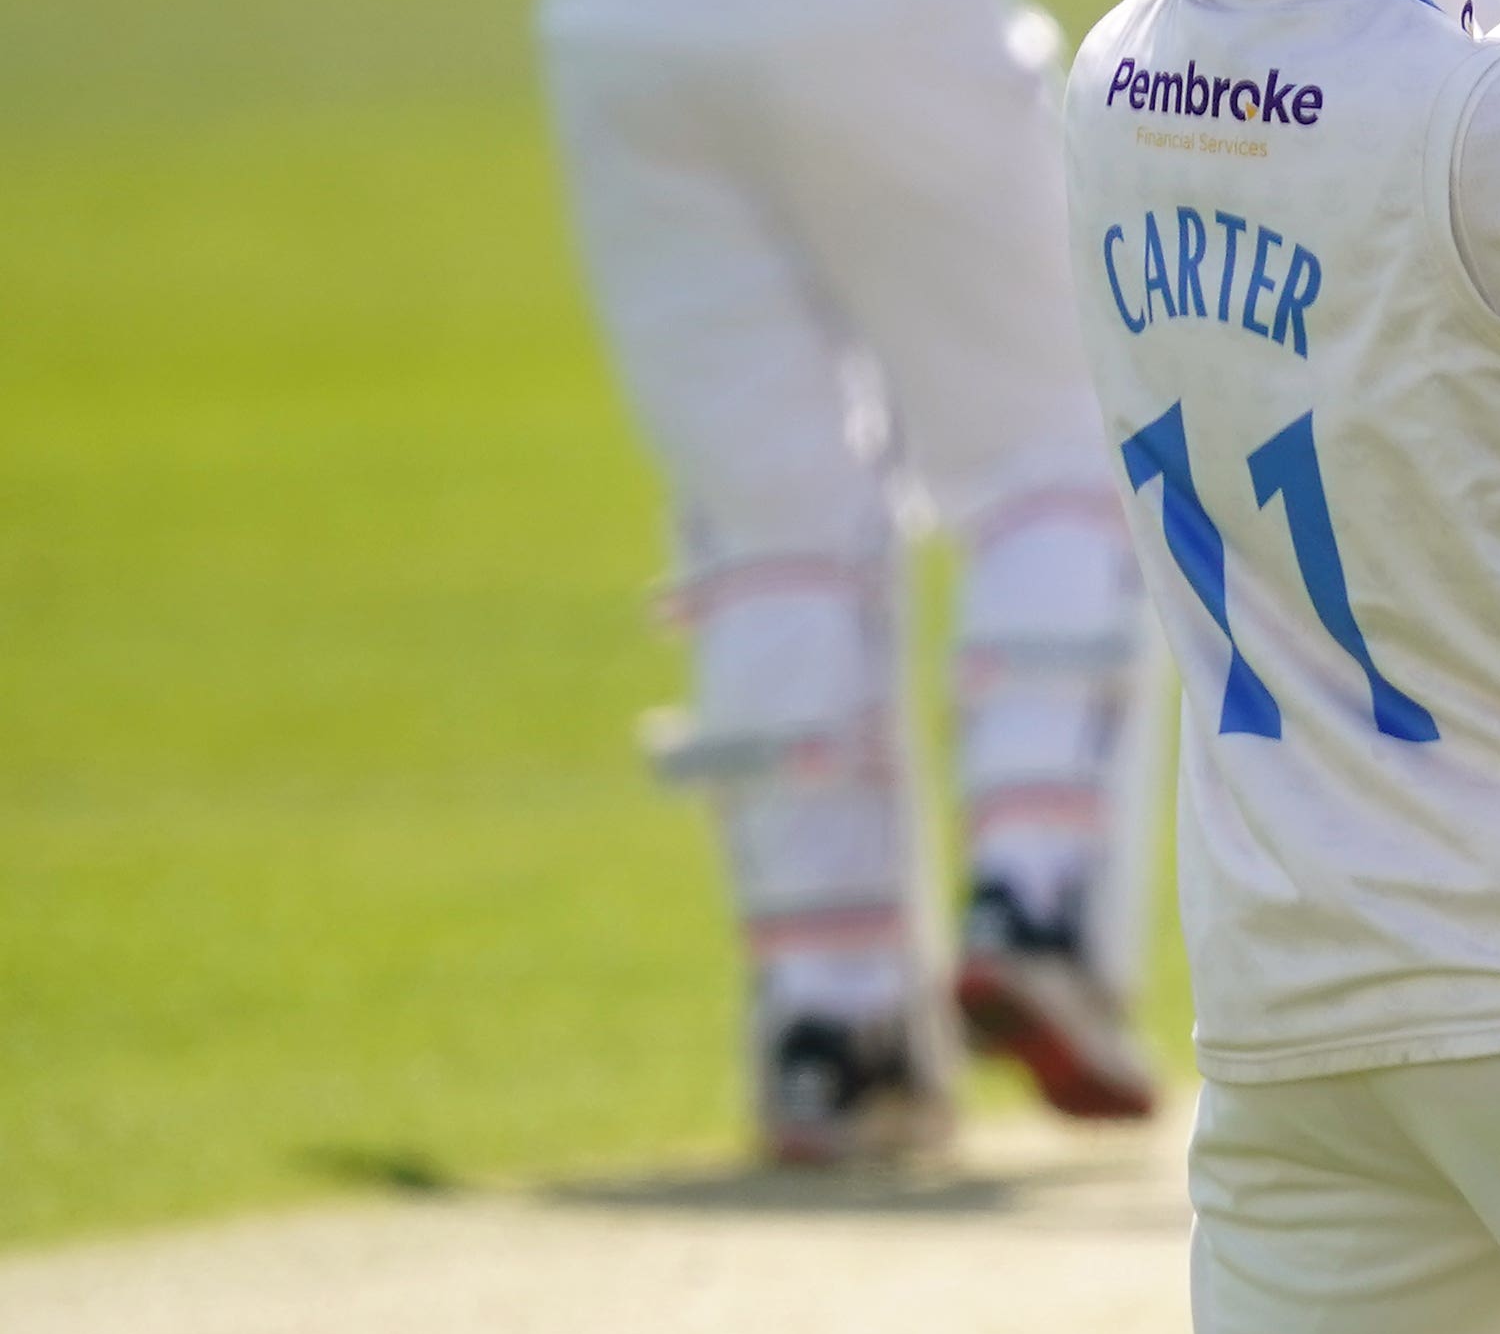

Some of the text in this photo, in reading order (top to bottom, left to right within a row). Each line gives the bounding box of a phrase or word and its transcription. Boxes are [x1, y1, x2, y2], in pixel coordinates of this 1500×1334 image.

[1106, 57, 1324, 126] Pembroke
[1136, 126, 1268, 157] Financial Services
[1103, 205, 1322, 360] CARTER
[1120, 398, 1441, 742] 11
